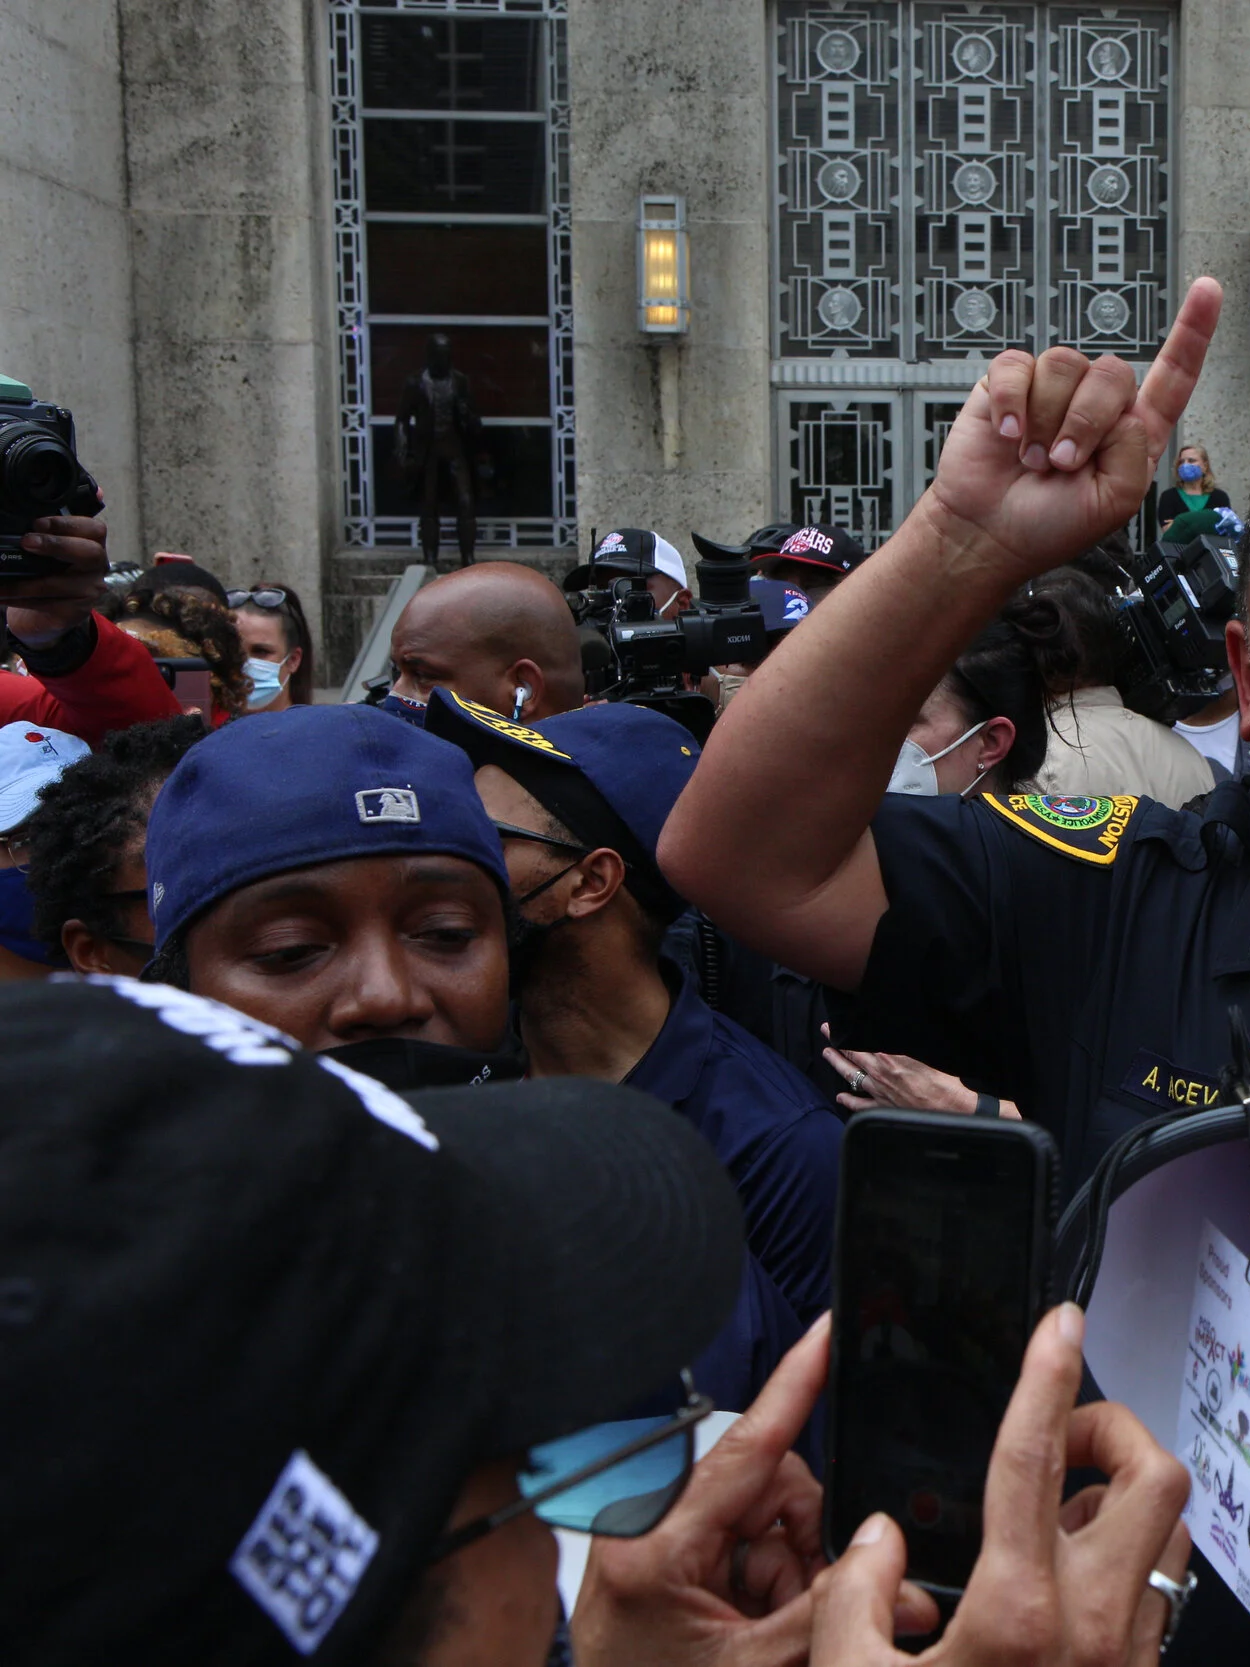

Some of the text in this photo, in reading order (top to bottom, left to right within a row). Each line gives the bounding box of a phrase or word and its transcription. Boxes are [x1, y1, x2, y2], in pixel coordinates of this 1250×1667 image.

[1144, 564, 1163, 584] Dejero
[1142, 1066, 1219, 1105] A. ACEV
